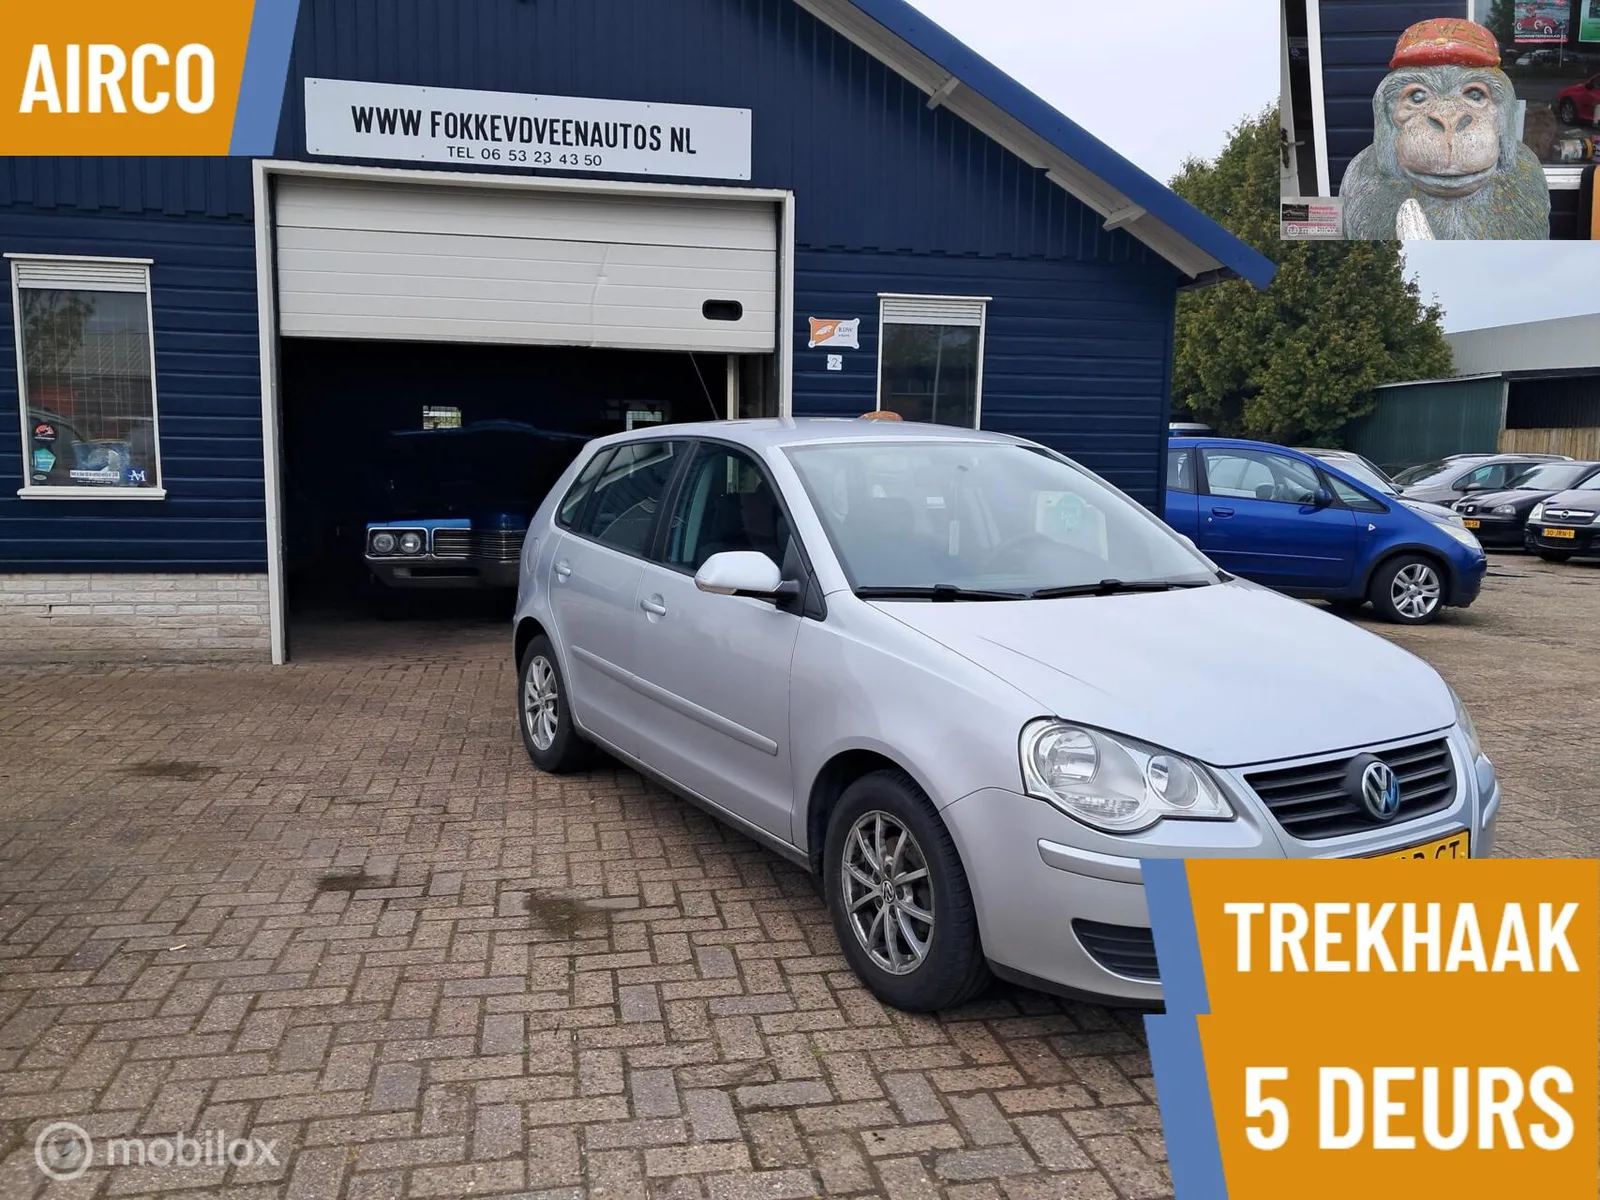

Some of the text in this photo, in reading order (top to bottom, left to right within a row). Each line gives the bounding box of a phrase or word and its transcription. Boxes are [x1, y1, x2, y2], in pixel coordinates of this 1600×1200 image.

[351, 105, 697, 155] WWW FOKKEVDVEENAUTOS NL
[447, 145, 602, 167] TEL 06 53 23 43 50
[831, 358, 838, 368] 2
